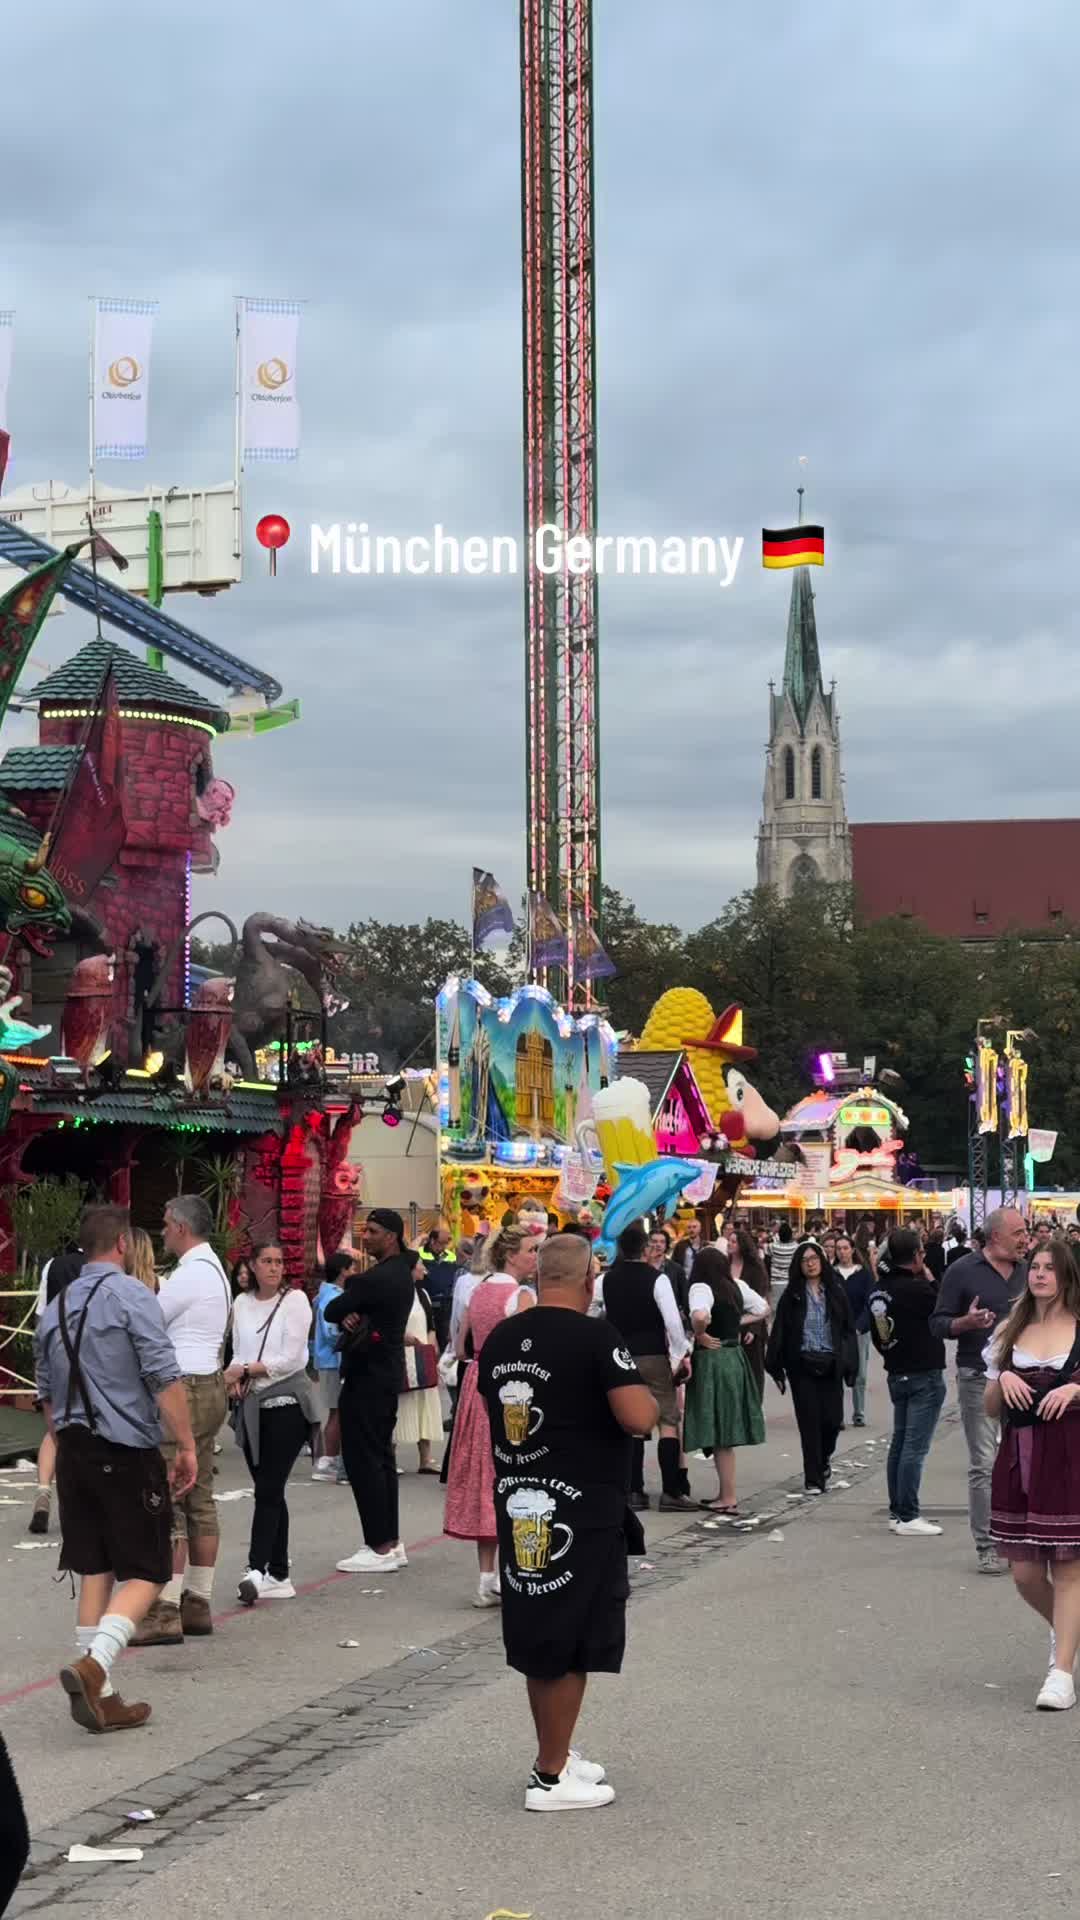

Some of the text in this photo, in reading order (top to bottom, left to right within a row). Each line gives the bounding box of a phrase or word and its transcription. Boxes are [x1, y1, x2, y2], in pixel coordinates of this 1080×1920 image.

[491, 1360, 551, 1381] Oktoberfest
[515, 1445, 550, 1465] Verona
[527, 1570, 573, 1596] Verona
